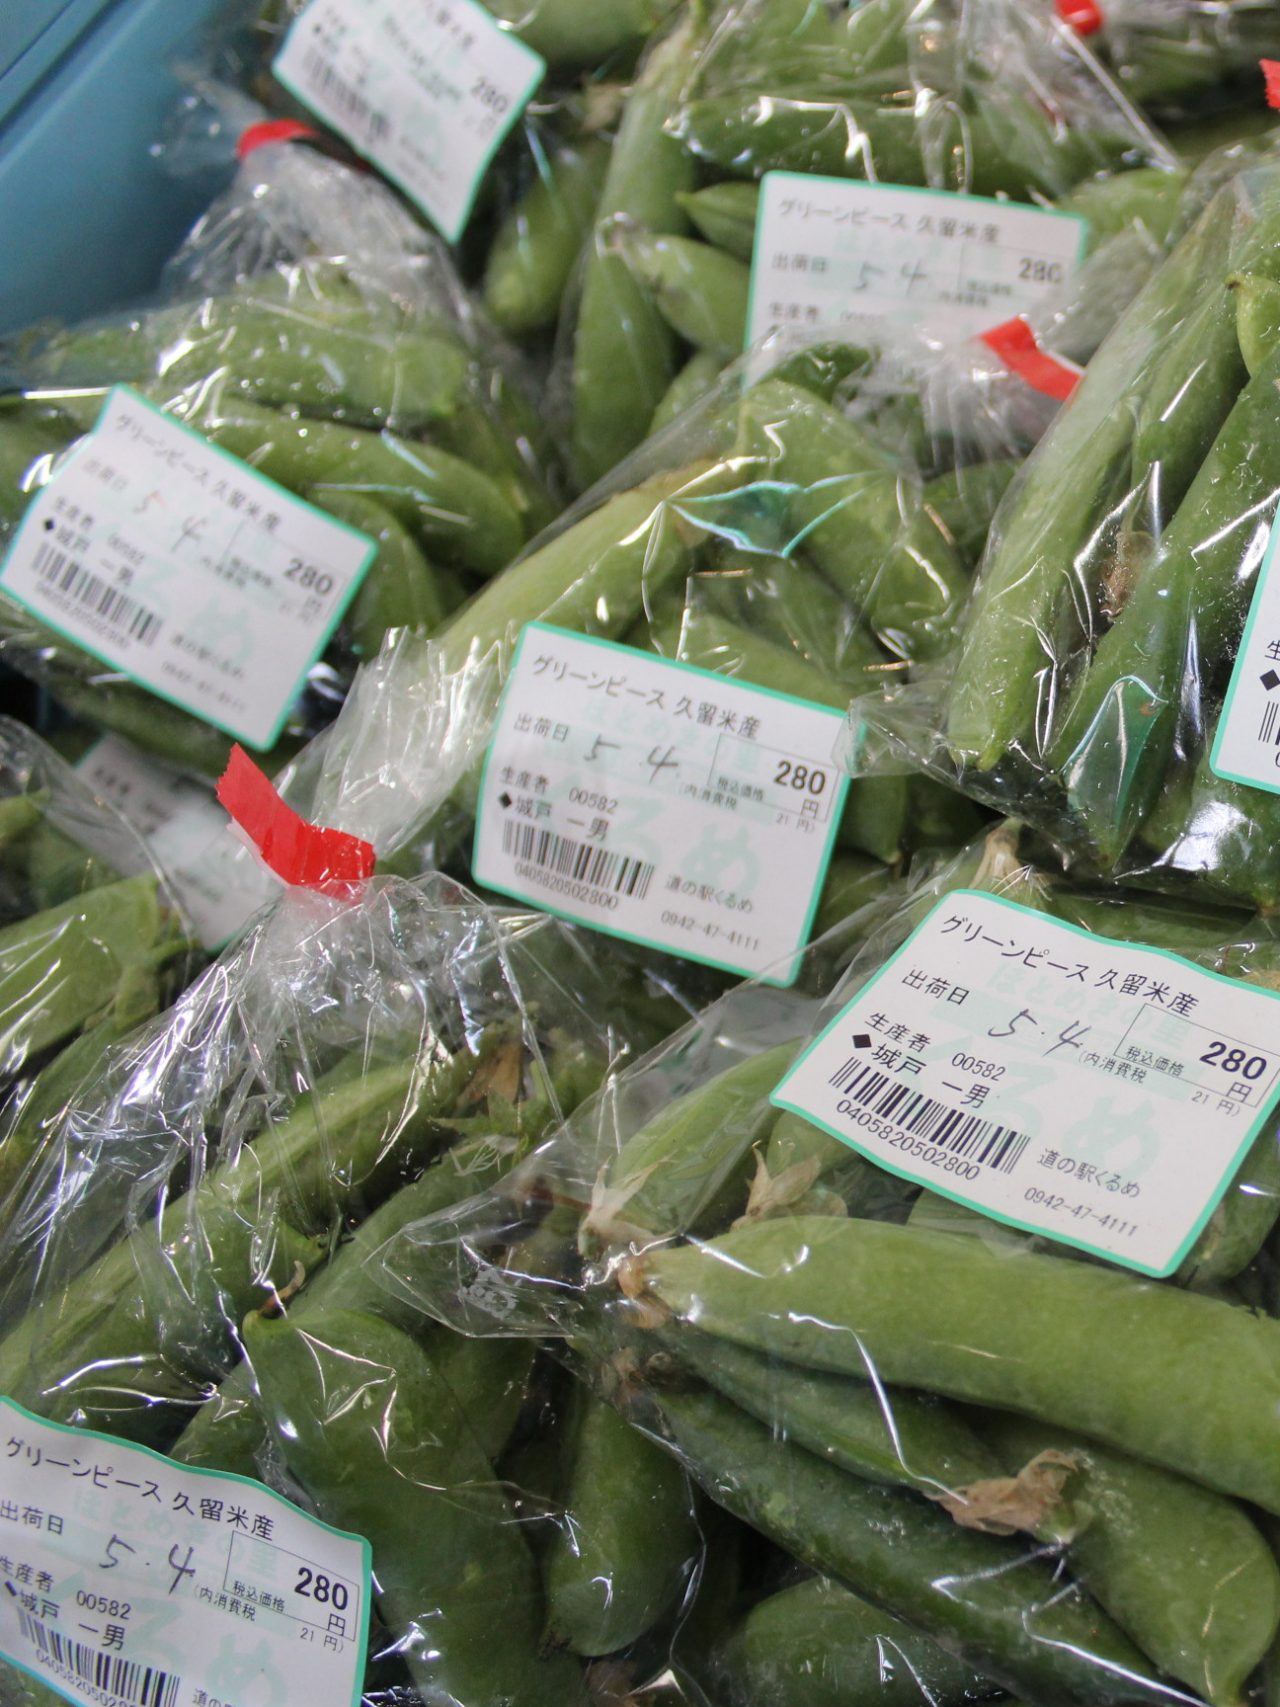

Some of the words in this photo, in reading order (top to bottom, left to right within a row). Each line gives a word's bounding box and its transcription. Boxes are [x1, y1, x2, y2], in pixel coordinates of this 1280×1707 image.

[283, 557, 334, 595] 280
[534, 654, 666, 710] グリーンピース
[674, 696, 762, 739] 久留米産
[514, 713, 571, 742] 出荷日
[501, 766, 549, 795] 生産者
[569, 787, 619, 814] 00582
[773, 761, 826, 795] 280
[902, 969, 971, 1006] 出荷日
[940, 915, 1101, 983] グリーンピース
[1094, 968, 1199, 1017] 久留米産
[865, 1011, 933, 1053] 生産者
[952, 1051, 1006, 1083] 00582
[1126, 1045, 1185, 1077] 税込価格
[1200, 1041, 1267, 1079] 280
[836, 1099, 981, 1181] 0405820502800
[1036, 1148, 1141, 1198] 道の駅くるめ
[1024, 1186, 1139, 1237] 0942-47-4111
[7, 1436, 161, 1503] グリーンピース
[173, 1491, 275, 1541] 久留米産
[0, 1499, 64, 1536] 出荷日
[0, 1555, 55, 1594] 生産者
[76, 1590, 132, 1621] 00582
[233, 1579, 285, 1612] 税込価格
[294, 1567, 349, 1611] 280
